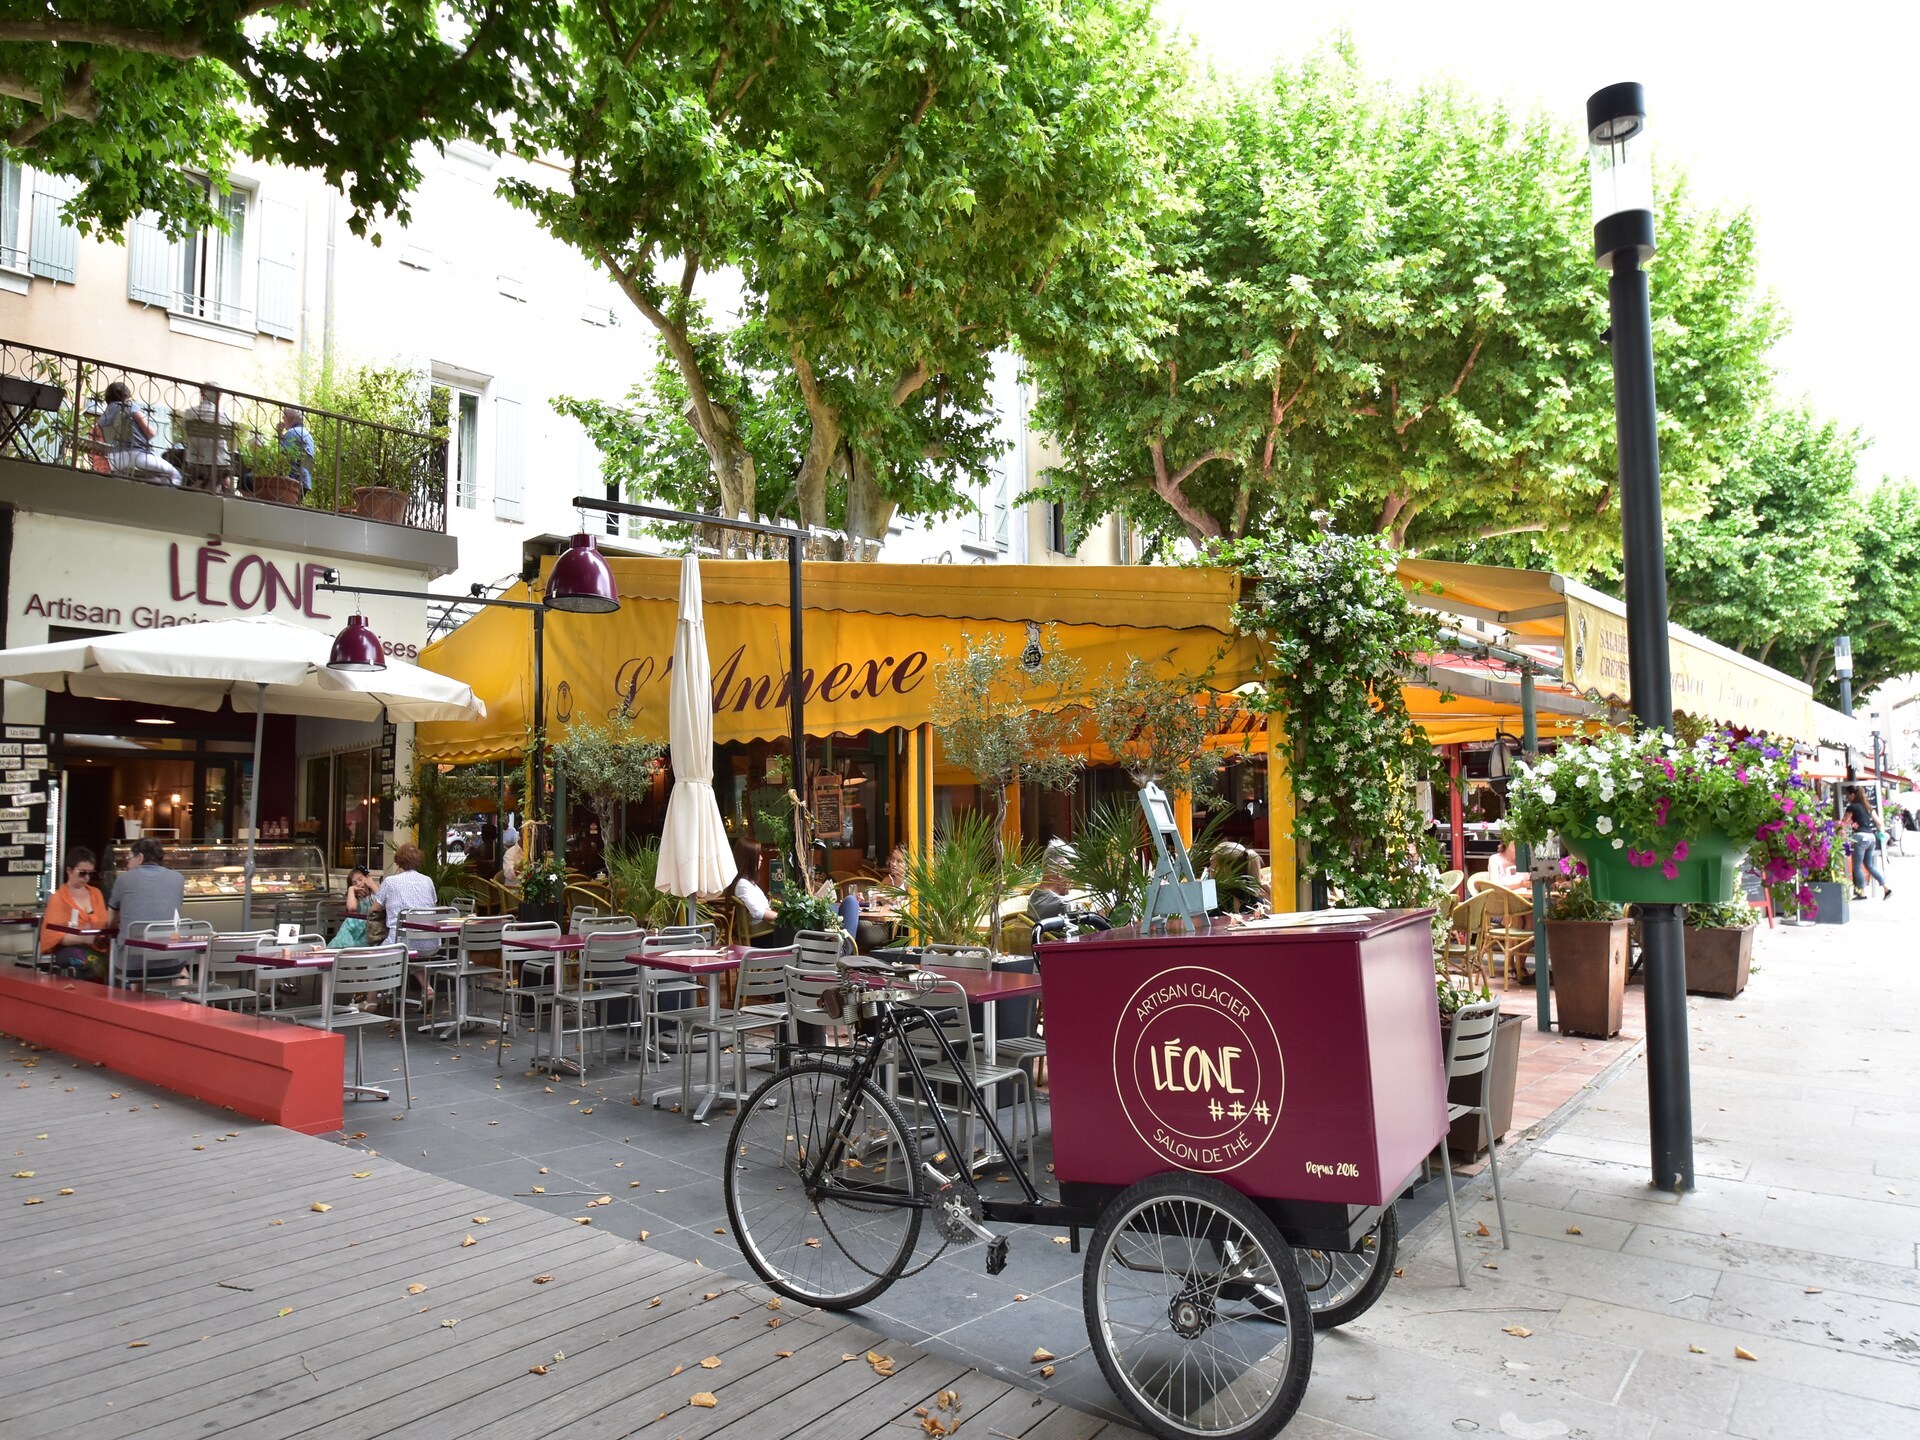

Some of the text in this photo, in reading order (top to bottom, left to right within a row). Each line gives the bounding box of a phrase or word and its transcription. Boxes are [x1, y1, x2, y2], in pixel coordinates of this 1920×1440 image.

[169, 540, 331, 619] LÉONE
[24, 593, 121, 625] Artisan
[607, 643, 928, 719] L'Annexe
[1136, 983, 1250, 1023] ARTISAN GLACIER
[1150, 1037, 1244, 1093] LÉONE
[1152, 1128, 1252, 1163] SALON DE THÉ
[1336, 1162, 1359, 1178] 2016
